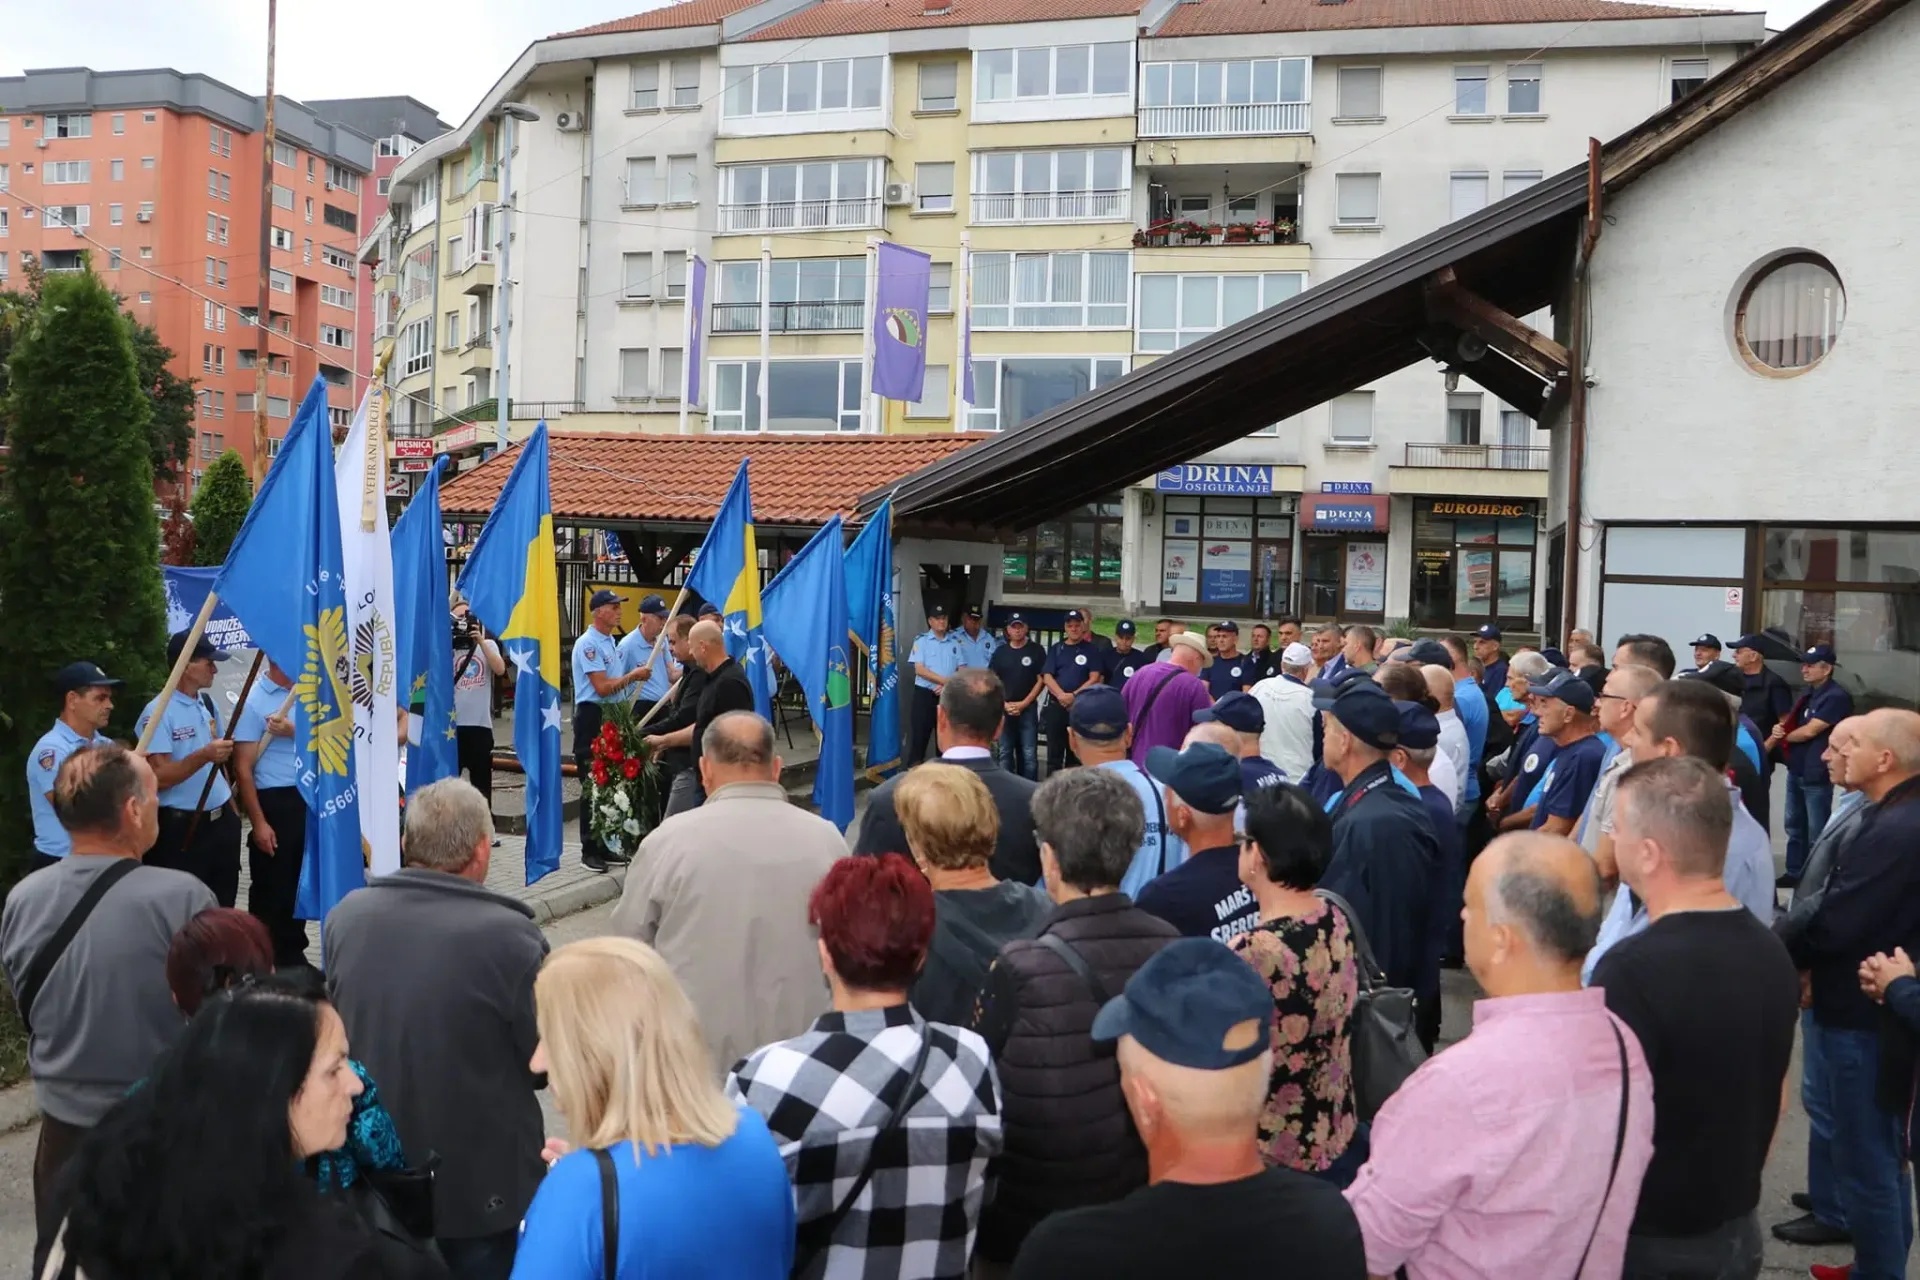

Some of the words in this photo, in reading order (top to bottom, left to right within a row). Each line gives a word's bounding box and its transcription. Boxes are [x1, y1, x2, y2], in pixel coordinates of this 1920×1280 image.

[397, 440, 432, 449] MESNICA
[366, 444, 377, 495] VETERANI
[1187, 465, 1270, 484] DRINA
[1185, 483, 1269, 493] OSIGURANJE
[1334, 482, 1370, 491] DRINA
[1432, 502, 1524, 516] EUROHERC
[1214, 884, 1251, 921] MARŠ
